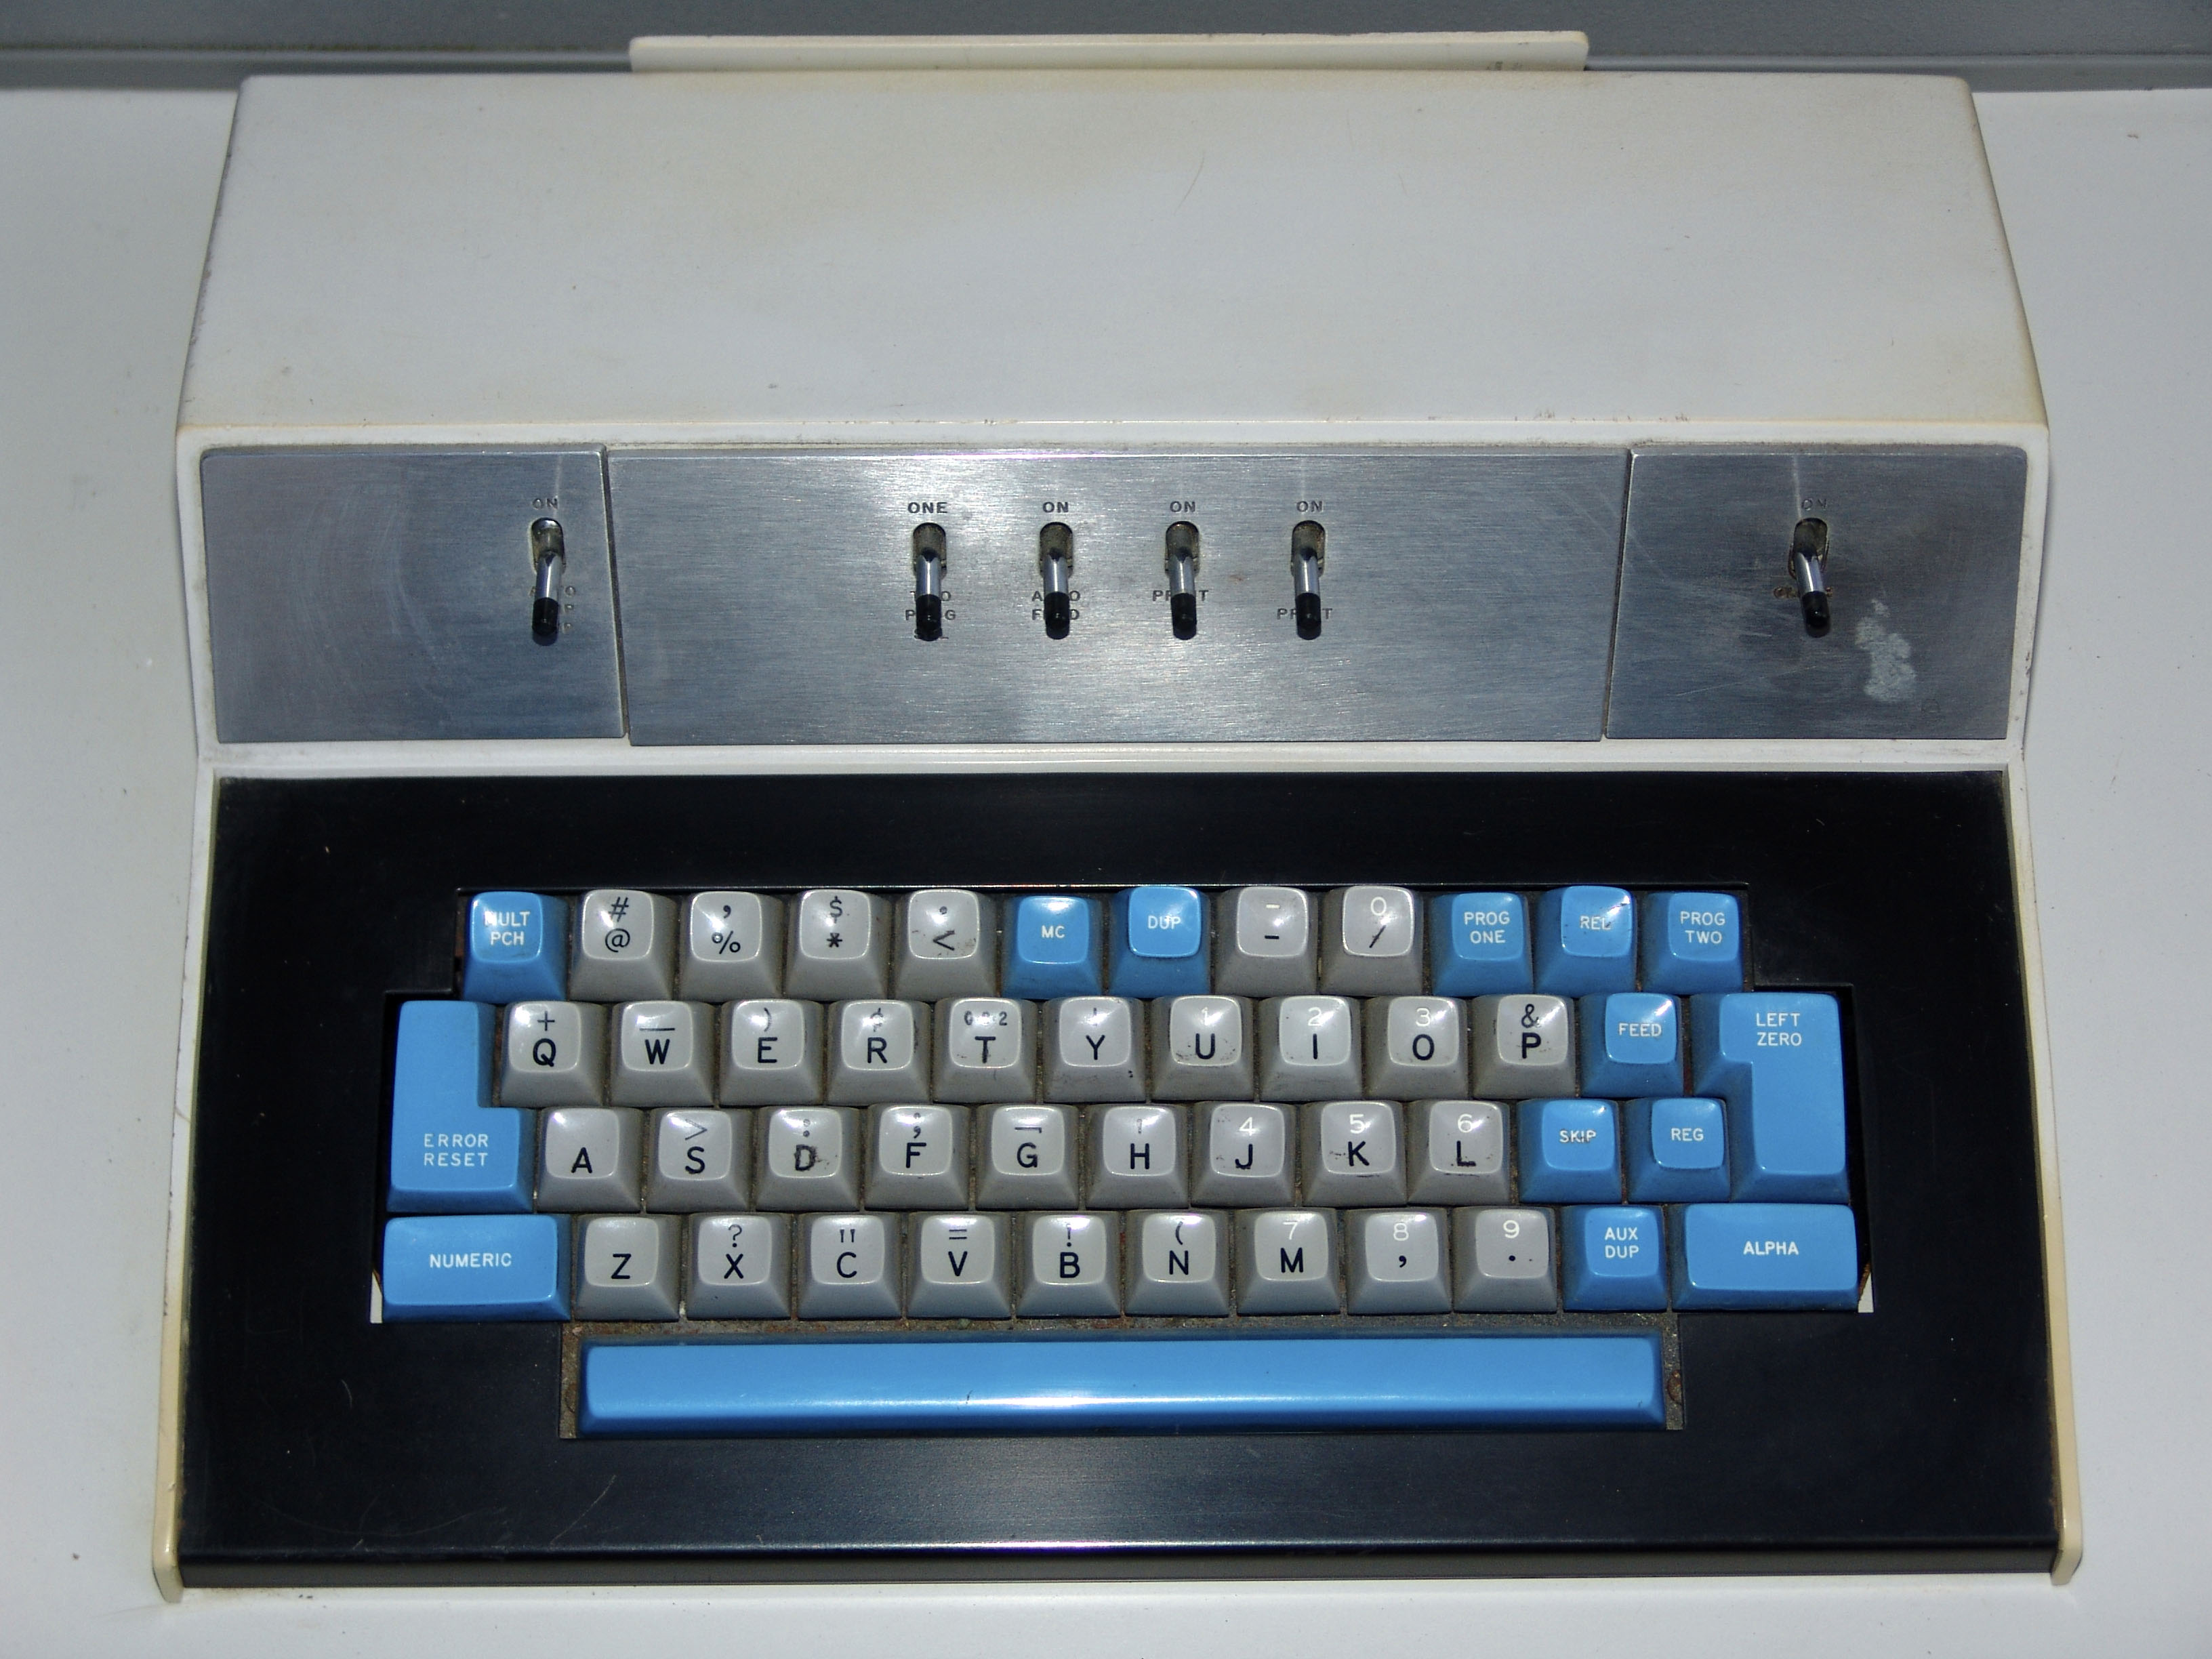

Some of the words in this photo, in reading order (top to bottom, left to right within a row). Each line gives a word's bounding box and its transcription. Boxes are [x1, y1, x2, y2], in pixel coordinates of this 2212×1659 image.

[532, 498, 558, 509] ON
[907, 501, 948, 514] ONE
[1042, 501, 1069, 513] ON
[1170, 501, 1196, 512] ON
[1296, 500, 1324, 512] ON
[1031, 590, 1081, 602] AO
[905, 609, 956, 621] PG
[1031, 609, 1080, 620] FD
[484, 910, 531, 926] MULT
[1147, 915, 1181, 930] DUP
[1463, 912, 1511, 926] PROG
[1580, 915, 1611, 930] REL
[1679, 911, 1726, 926] PROG
[490, 930, 525, 946] PCH
[605, 928, 631, 953] @
[1041, 925, 1065, 939] MC
[1469, 929, 1506, 944] ONE
[1685, 929, 1723, 945] TWO
[712, 930, 741, 955] %
[1307, 1006, 1324, 1027] 2
[1415, 1007, 1431, 1027] 3
[1520, 1003, 1539, 1029] &
[1756, 1012, 1801, 1027] LEFT
[1618, 1023, 1662, 1038] FEED
[1756, 1031, 1802, 1046] ZERO
[532, 1038, 556, 1067] Q
[644, 1038, 670, 1065] W
[757, 1037, 778, 1064] E
[867, 1037, 888, 1064] R
[975, 1036, 996, 1064] T
[1086, 1034, 1105, 1061] Y
[1195, 1033, 1216, 1060] U
[1312, 1033, 1318, 1060] I
[1412, 1033, 1435, 1061] O
[1521, 1032, 1542, 1059] P
[1239, 1116, 1256, 1137] 4
[1349, 1113, 1366, 1134] 5
[1457, 1113, 1475, 1133] 6
[424, 1133, 489, 1147] ERROR
[1559, 1129, 1597, 1144] SKIP
[1671, 1128, 1704, 1143] REG
[424, 1152, 489, 1167] RESET
[571, 1147, 593, 1174] A
[684, 1146, 705, 1174] S
[794, 1144, 815, 1171] D
[905, 1142, 927, 1169] F
[1017, 1142, 1038, 1168] G
[1130, 1143, 1150, 1170] H
[1234, 1143, 1254, 1170] J
[1347, 1141, 1370, 1167] K
[1456, 1140, 1477, 1167] L
[727, 1223, 743, 1248] ?
[1282, 1221, 1298, 1241] 7
[1393, 1222, 1410, 1242] 8
[1502, 1220, 1520, 1239] 9
[1604, 1227, 1639, 1241] AUX
[1604, 1244, 1639, 1258] DUP
[1742, 1241, 1799, 1256] ALPHA
[429, 1252, 512, 1269] NUMERIC
[611, 1253, 632, 1279] Z
[723, 1252, 744, 1279] X
[836, 1251, 858, 1279] C
[947, 1250, 968, 1277] V
[1059, 1251, 1080, 1278] B
[1168, 1250, 1189, 1275] N
[1279, 1247, 1304, 1273] M
